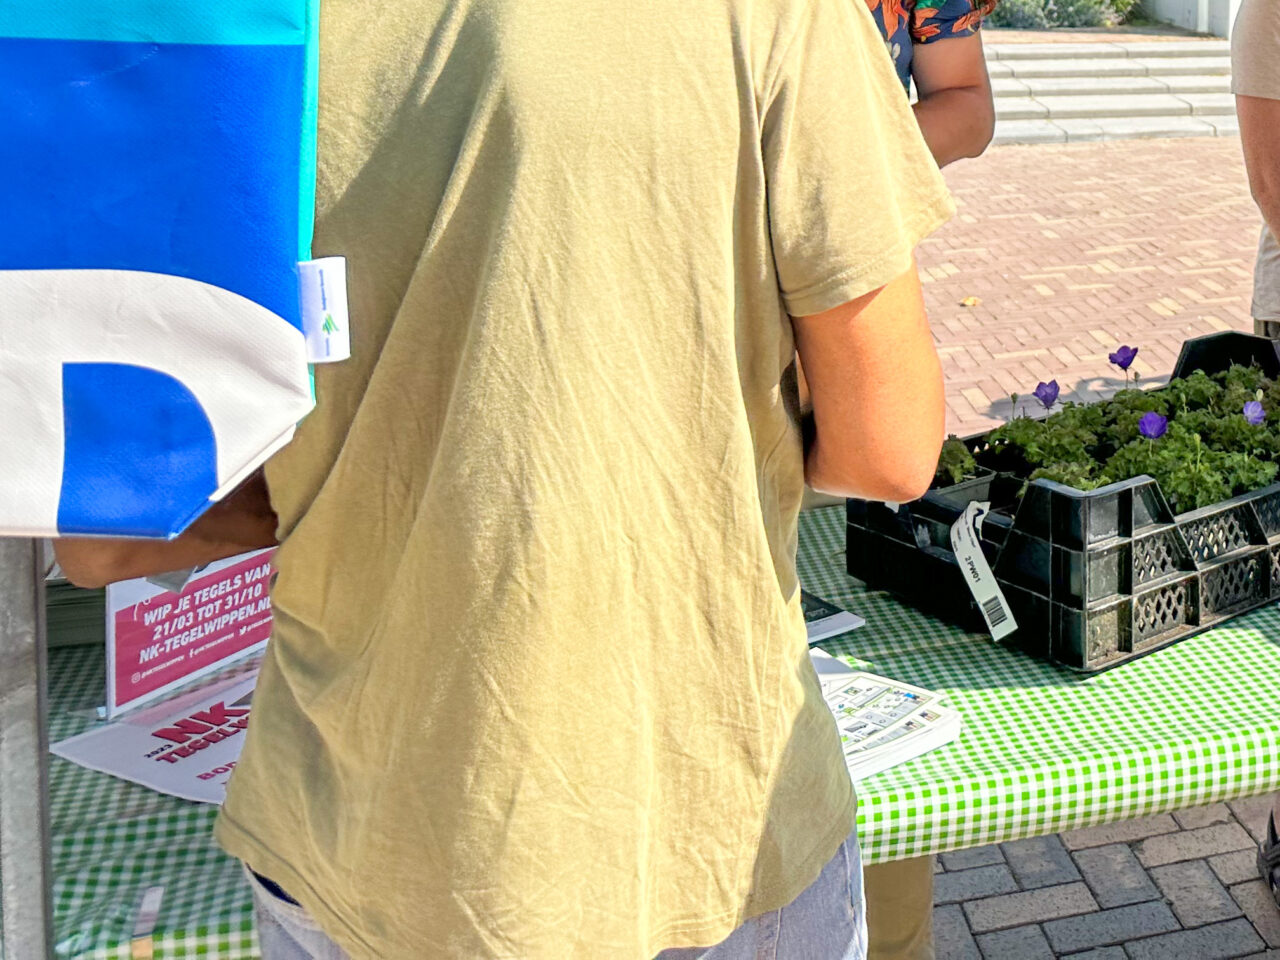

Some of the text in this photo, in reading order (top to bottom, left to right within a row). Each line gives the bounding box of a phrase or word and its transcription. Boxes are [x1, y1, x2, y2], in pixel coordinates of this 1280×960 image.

[143, 563, 271, 626] WIP JE TEGELS VAN
[153, 582, 263, 641] 21/03 TOT 31/10
[151, 701, 251, 744] NK
